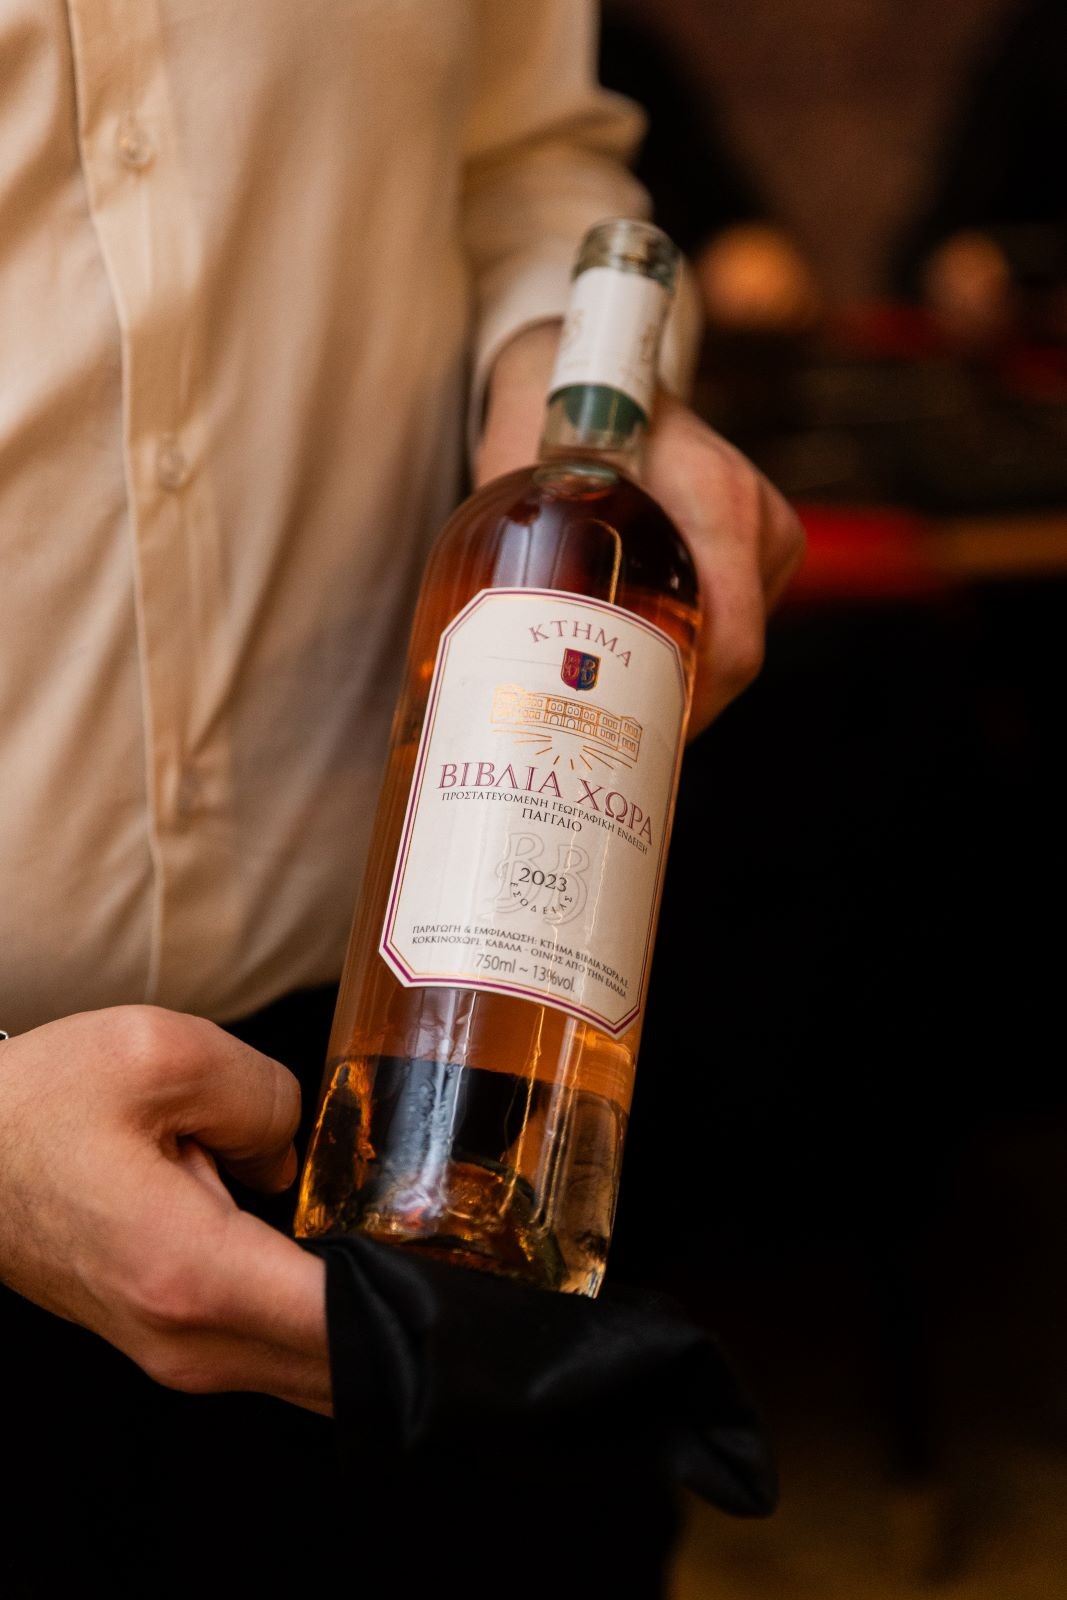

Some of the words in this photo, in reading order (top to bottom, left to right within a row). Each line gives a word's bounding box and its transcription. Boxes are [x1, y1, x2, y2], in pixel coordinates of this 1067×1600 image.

[528, 620, 632, 668] ΚΤΗΜΑ
[437, 762, 563, 799] ΒΙΒΛΙΑ
[574, 777, 653, 846] ΧΩΡΑ
[442, 791, 549, 809] ΠΡΟΣΤΑΤΕΥΟΜΕΝΗ
[552, 802, 615, 833] ΓΕΩΓΡΑΦΙΚΗ
[522, 808, 583, 832] ΠΑΓΓΑΙΟ
[518, 867, 568, 892] 2023
[475, 953, 517, 973] 750ml
